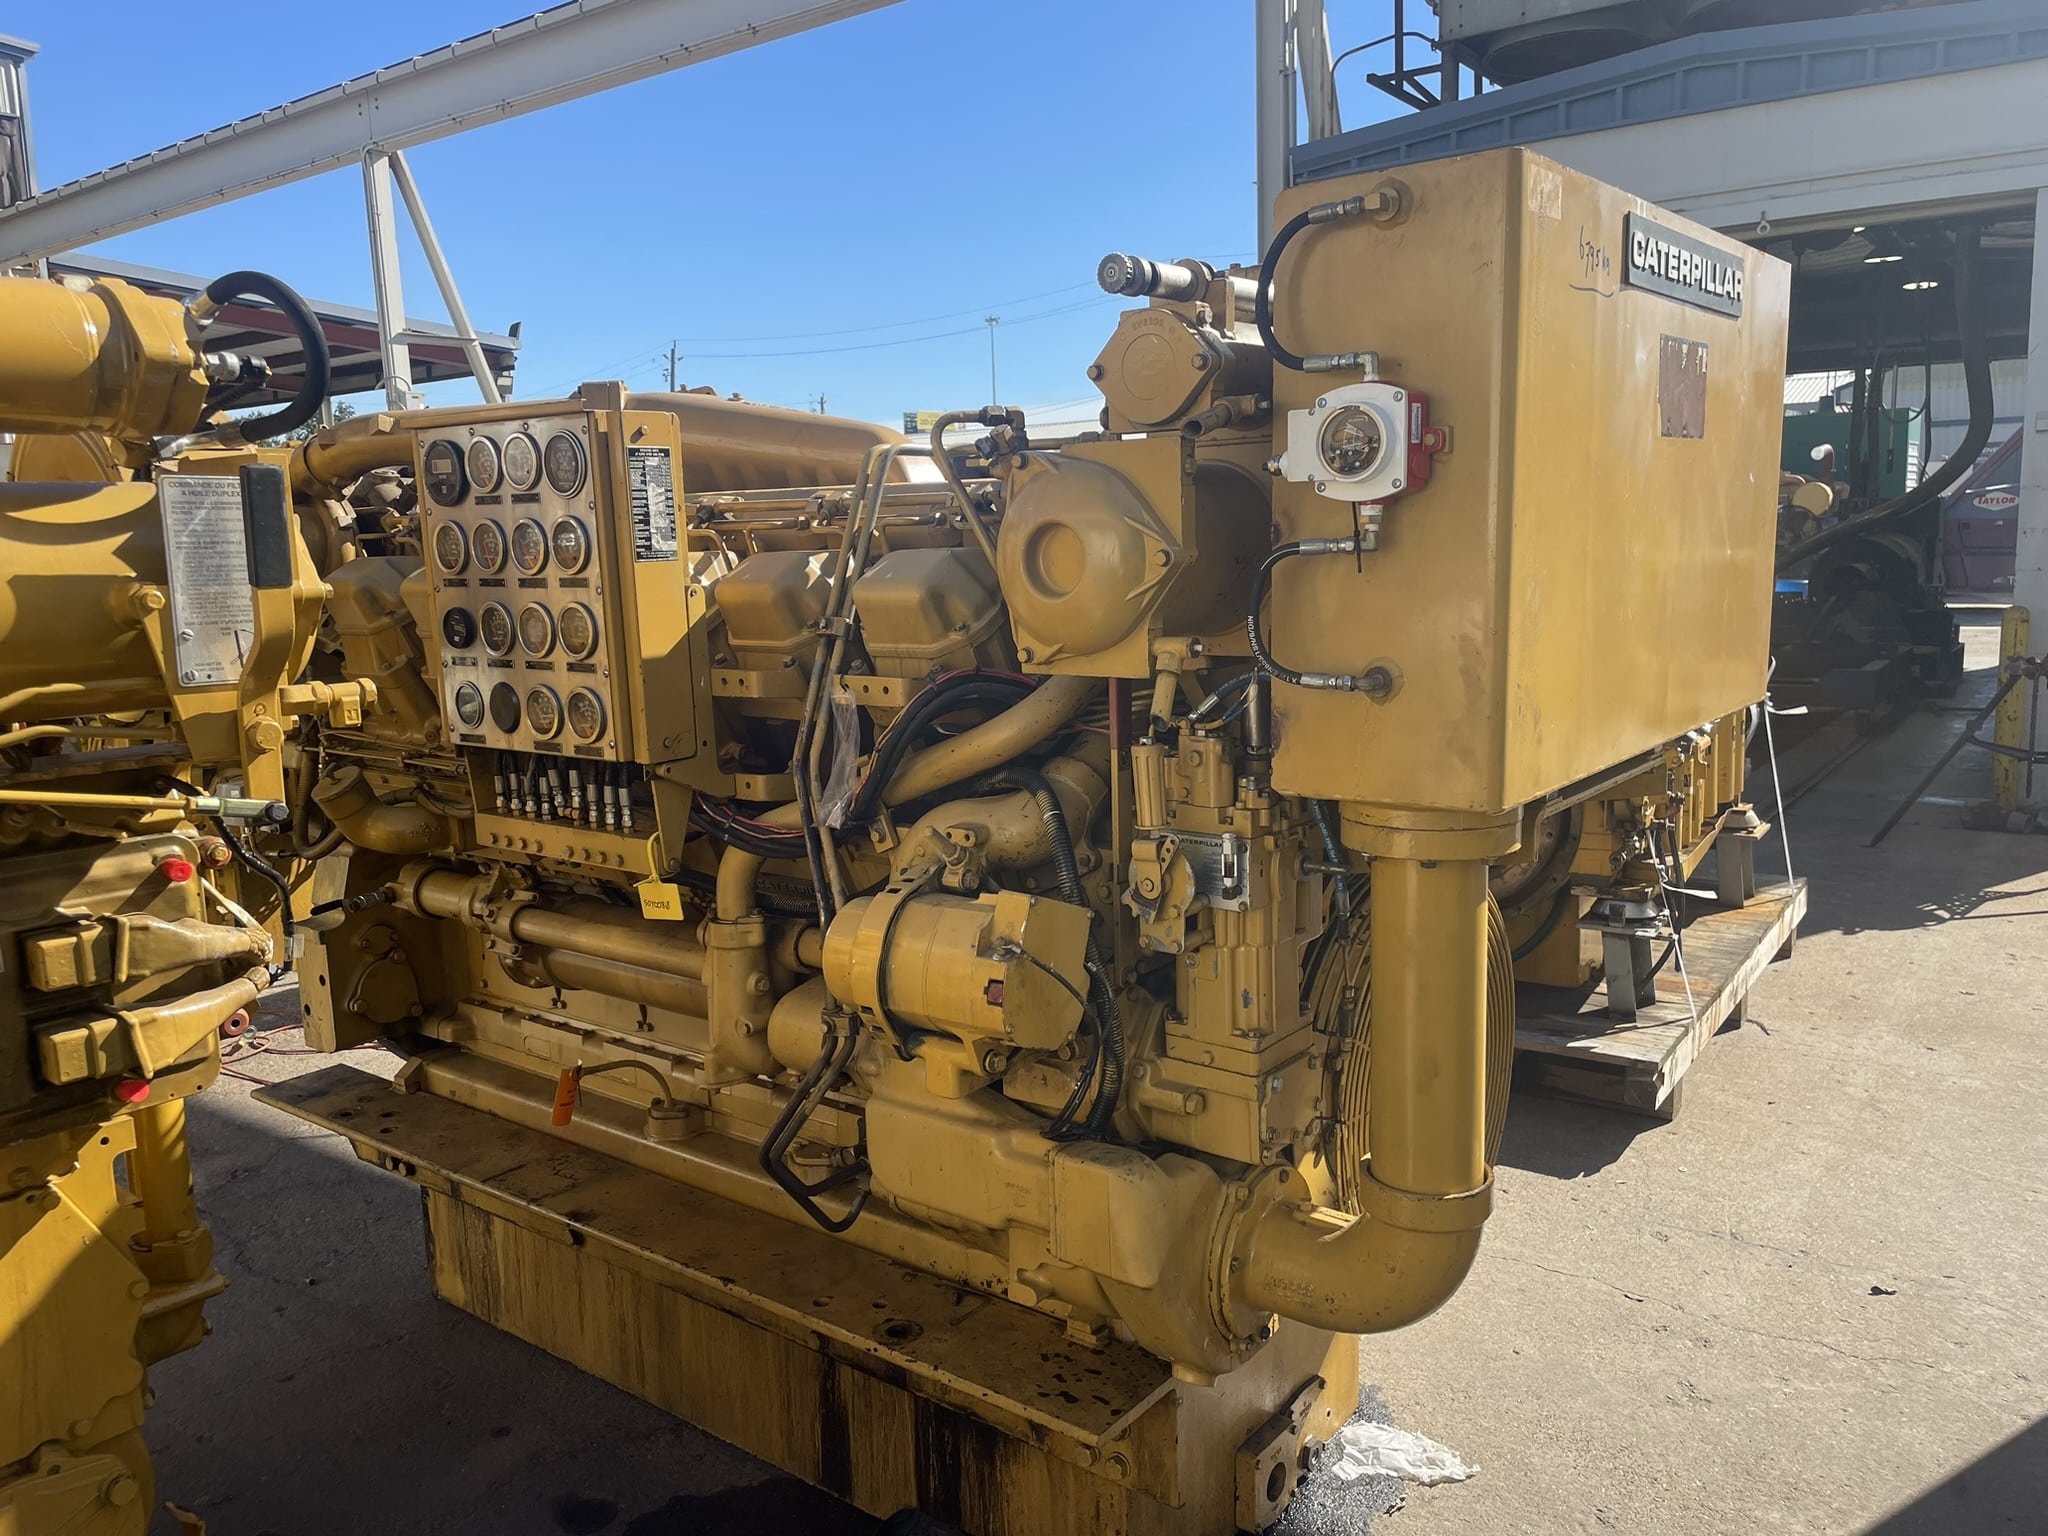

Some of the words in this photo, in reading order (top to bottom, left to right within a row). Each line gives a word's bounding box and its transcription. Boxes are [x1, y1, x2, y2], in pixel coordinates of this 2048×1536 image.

[1632, 229, 1744, 303] CATERPILLAR
[211, 490, 241, 498] DUPLEX
[1977, 495, 2017, 505] TAYLOR
[1180, 838, 1222, 848] ATERPILLA
